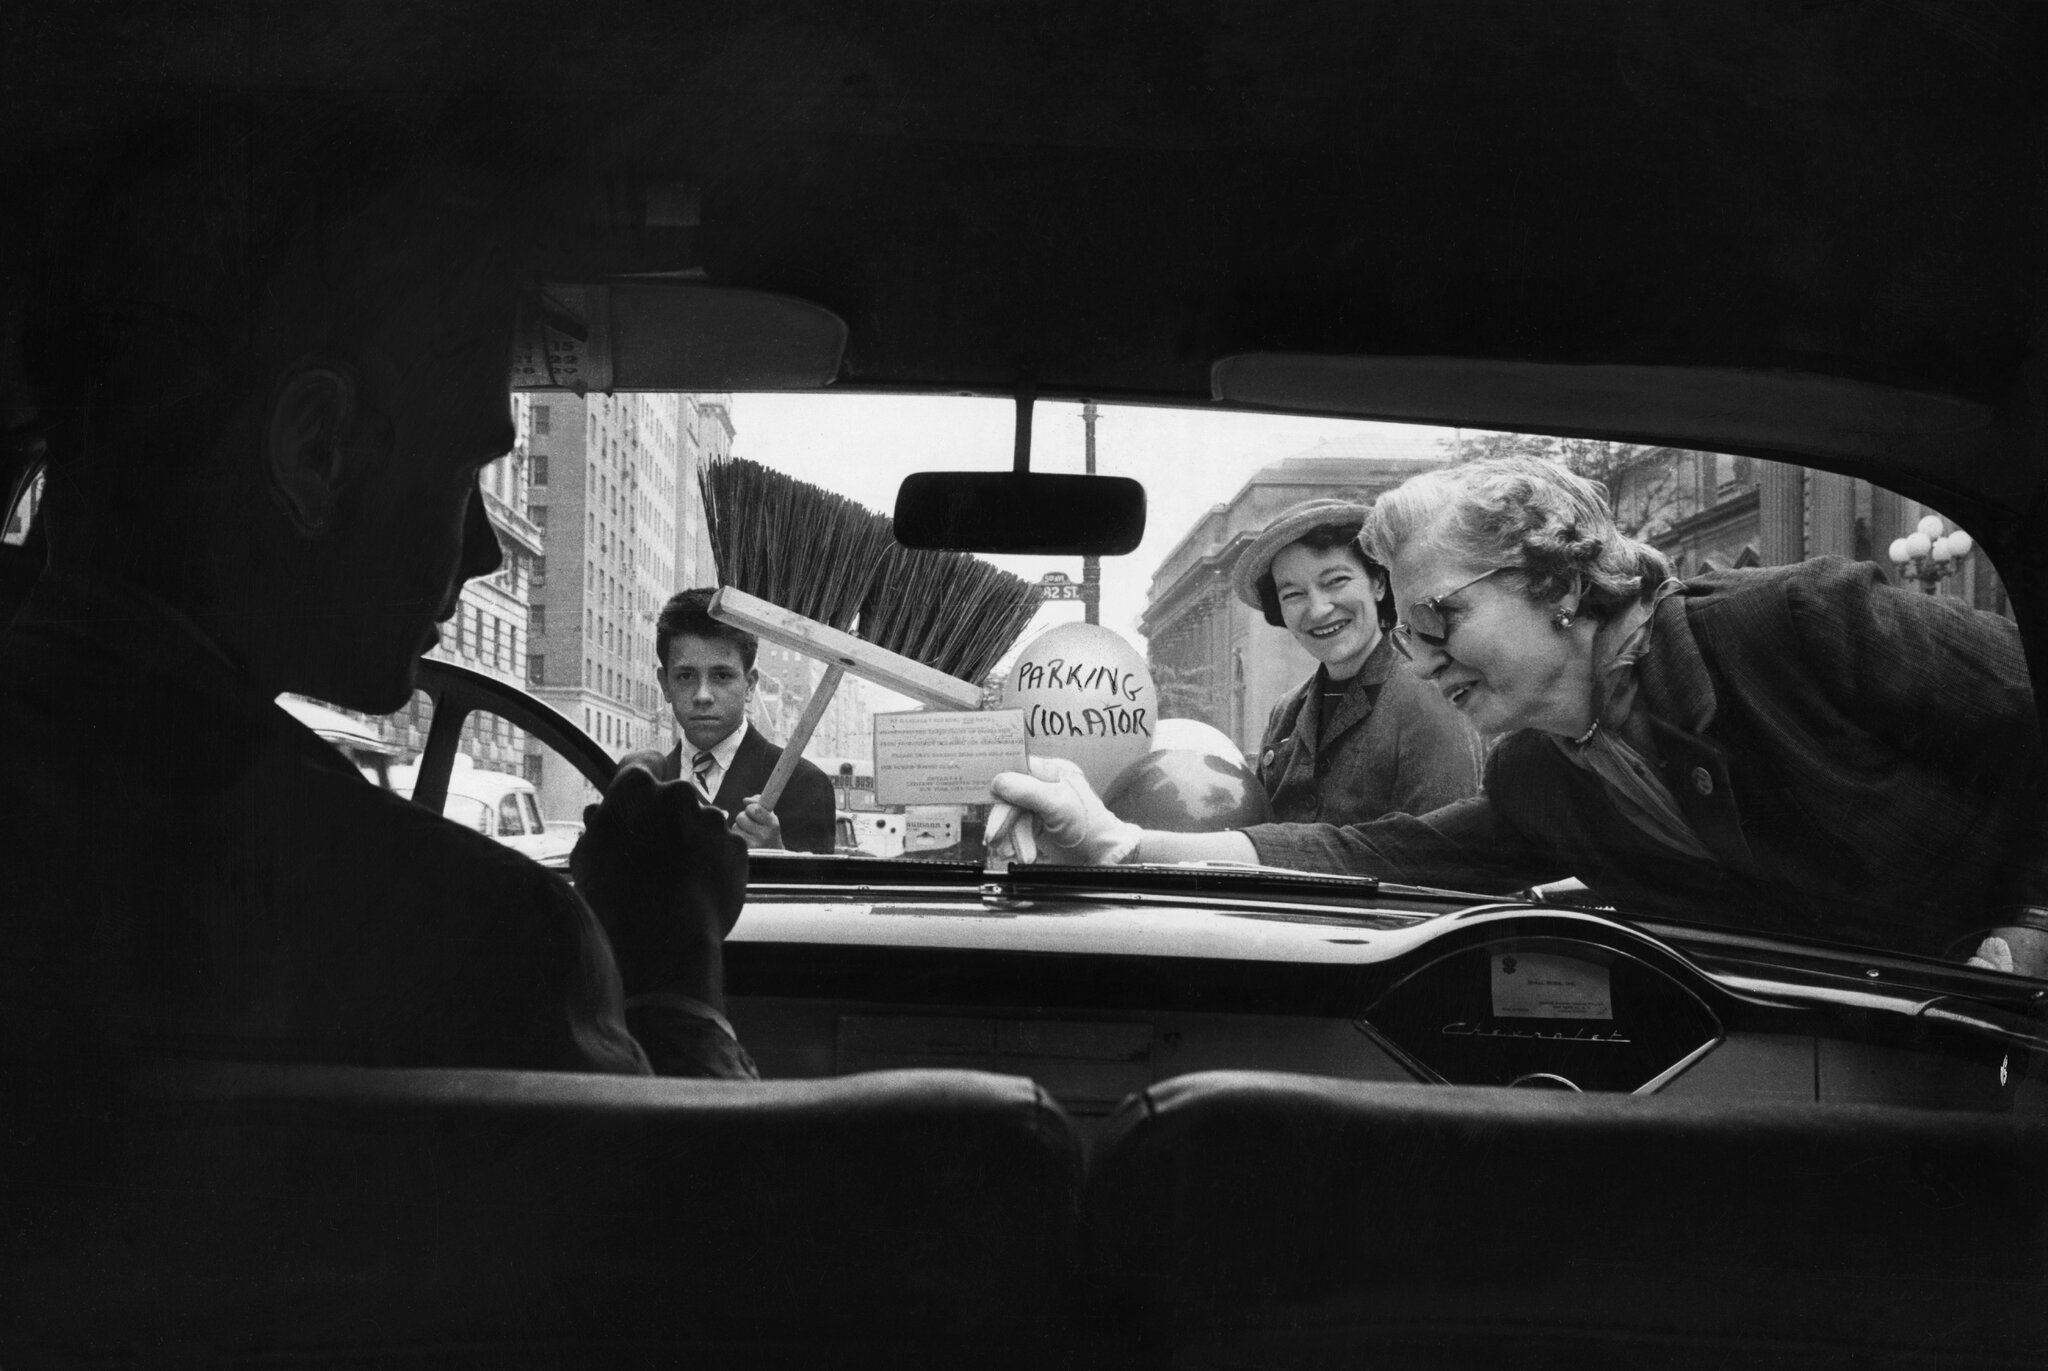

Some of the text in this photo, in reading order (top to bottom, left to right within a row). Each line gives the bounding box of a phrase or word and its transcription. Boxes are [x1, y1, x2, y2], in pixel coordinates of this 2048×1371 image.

[1018, 659, 1143, 701] PARKING
[1024, 704, 1150, 737] VIOLATOR
[1441, 1022, 1631, 1043] Chevrolet
